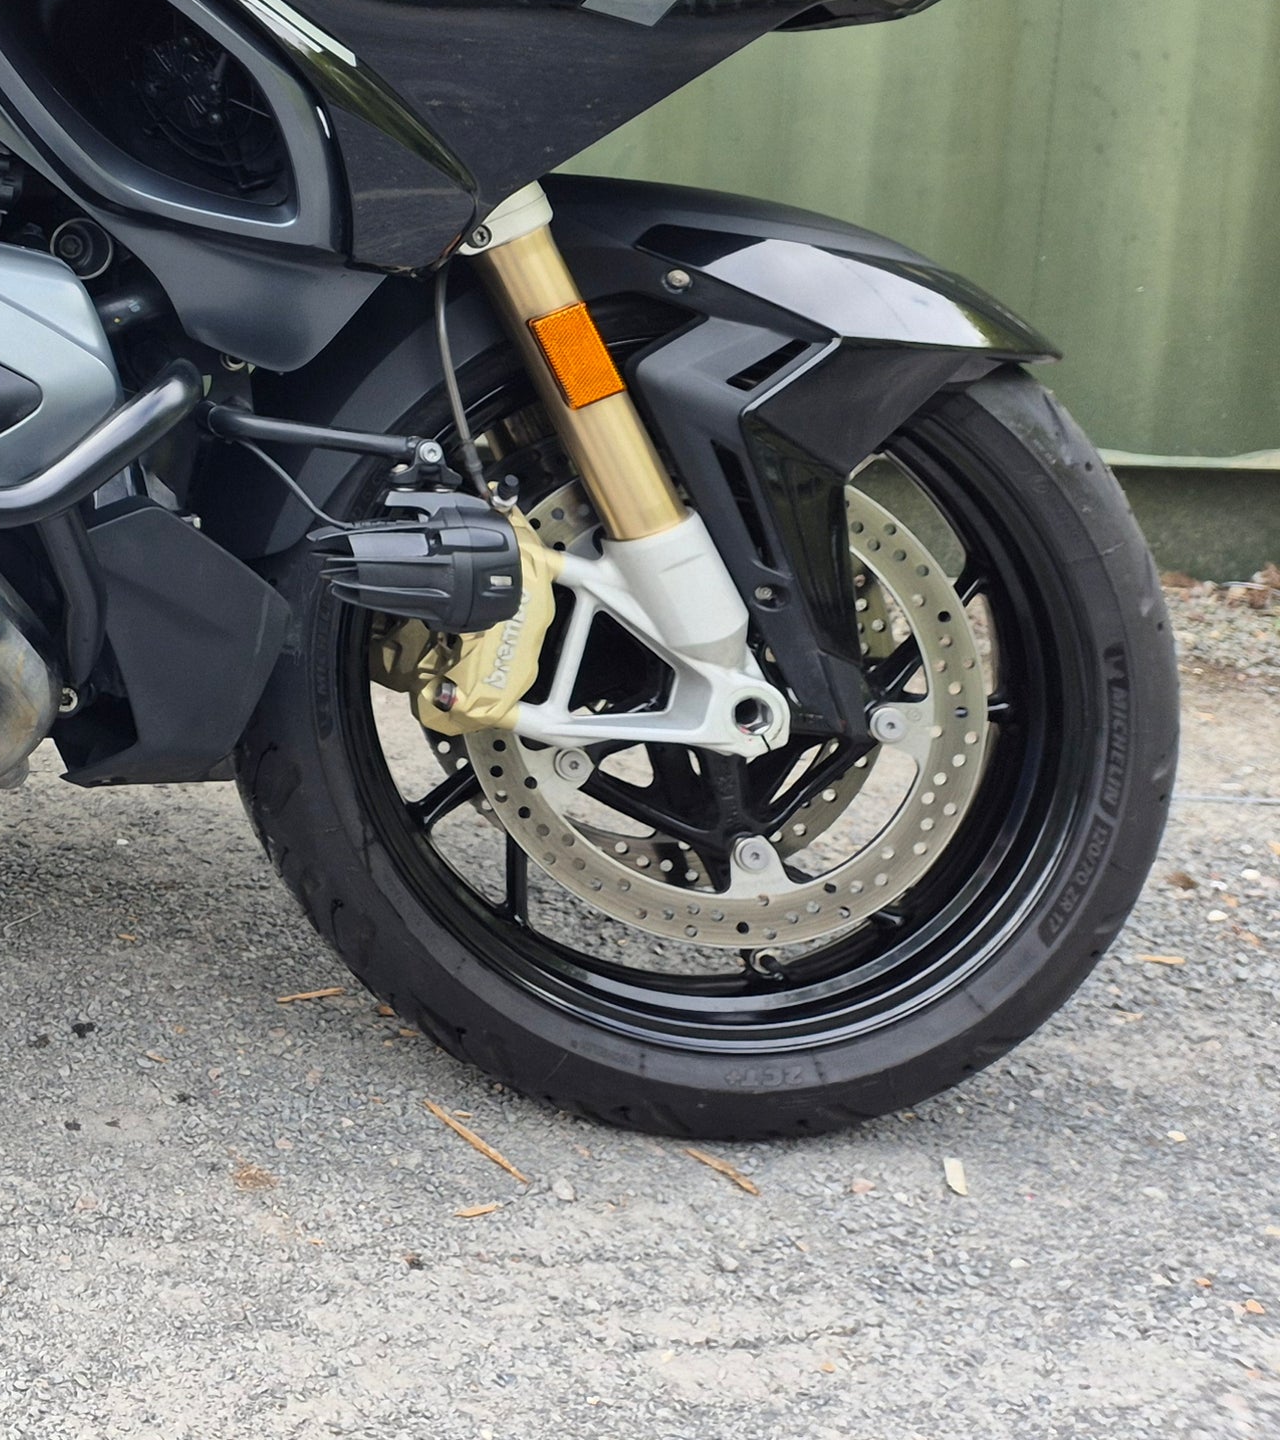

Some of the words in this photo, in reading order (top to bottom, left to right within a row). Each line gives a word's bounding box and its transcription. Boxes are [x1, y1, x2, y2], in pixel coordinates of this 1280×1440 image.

[1103, 686, 1130, 806] MICHELIN
[1076, 822, 1109, 886] 120/70
[1047, 914, 1065, 935] 17
